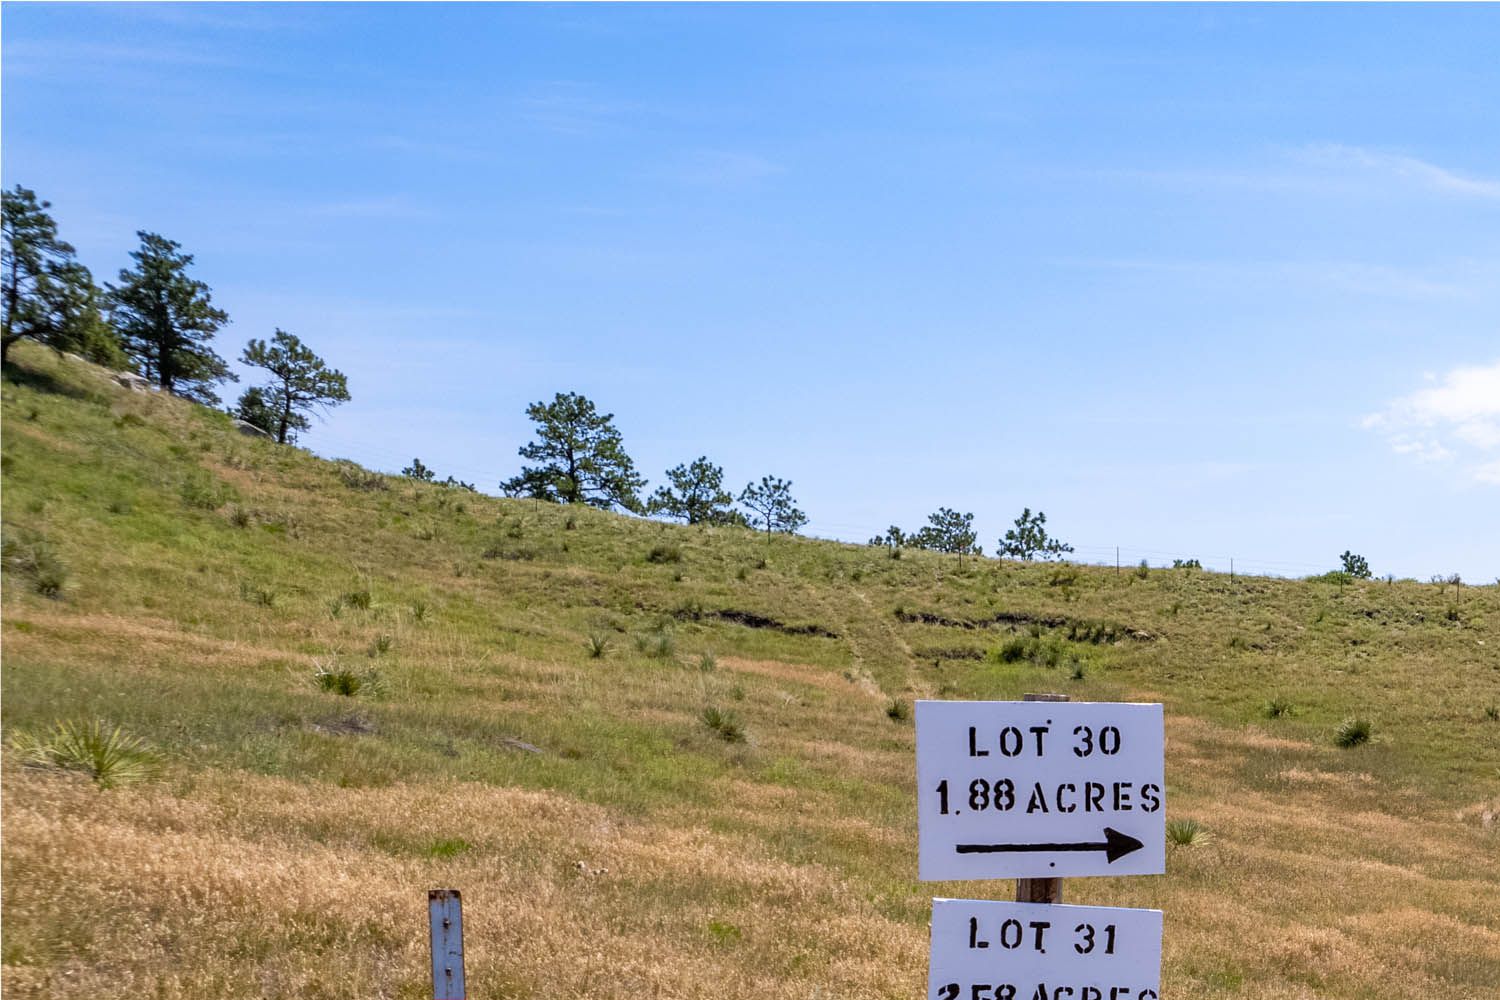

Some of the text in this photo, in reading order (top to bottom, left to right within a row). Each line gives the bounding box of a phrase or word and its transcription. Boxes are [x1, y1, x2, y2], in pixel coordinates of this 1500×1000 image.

[968, 725, 1121, 758] LOT 30
[935, 778, 1160, 815] 1.88 ACRES
[968, 916, 1116, 955] LOT 31
